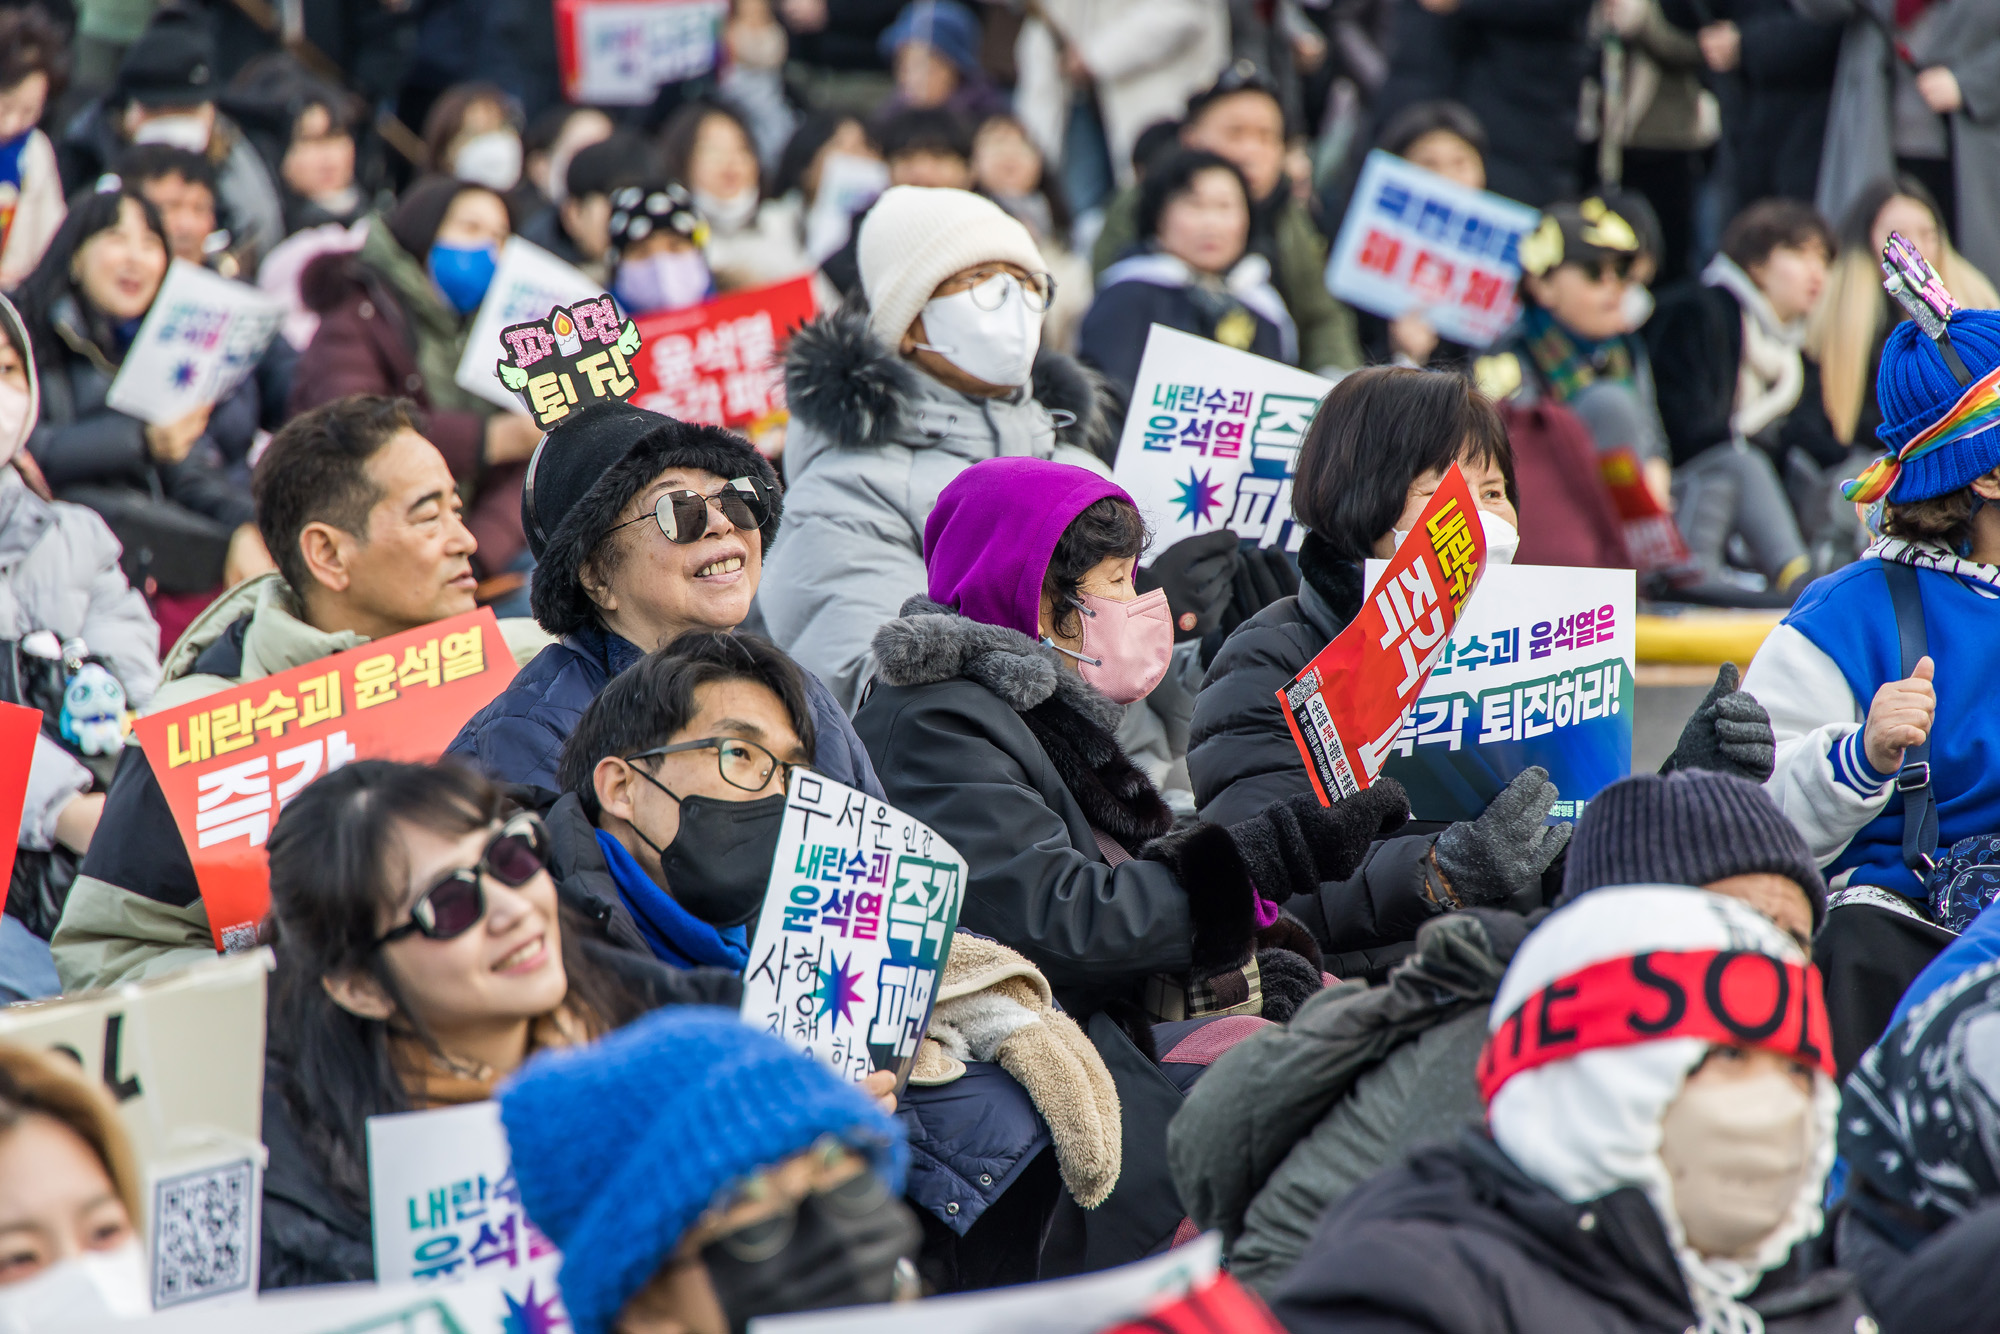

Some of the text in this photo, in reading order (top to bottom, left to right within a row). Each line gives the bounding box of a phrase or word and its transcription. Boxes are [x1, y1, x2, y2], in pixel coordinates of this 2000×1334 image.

[505, 299, 621, 368] 파면
[528, 345, 635, 425] 퇴진
[1152, 382, 1253, 418] 내란수괴
[1142, 414, 1246, 460] 윤석열
[1529, 603, 1616, 660] 윤석열은
[167, 625, 486, 769] 내란수괴 윤석열
[1479, 663, 1622, 745] 퇴진하라!
[1322, 723, 1335, 743] 파면
[1335, 758, 1349, 777] 해산
[1340, 775, 1357, 798] 촛불문
[788, 777, 934, 858] 무서운 인간
[794, 843, 891, 888] 내란수괴
[782, 885, 884, 941] 윤석열
[889, 861, 959, 961] 즉각
[869, 964, 937, 1058] 파면
